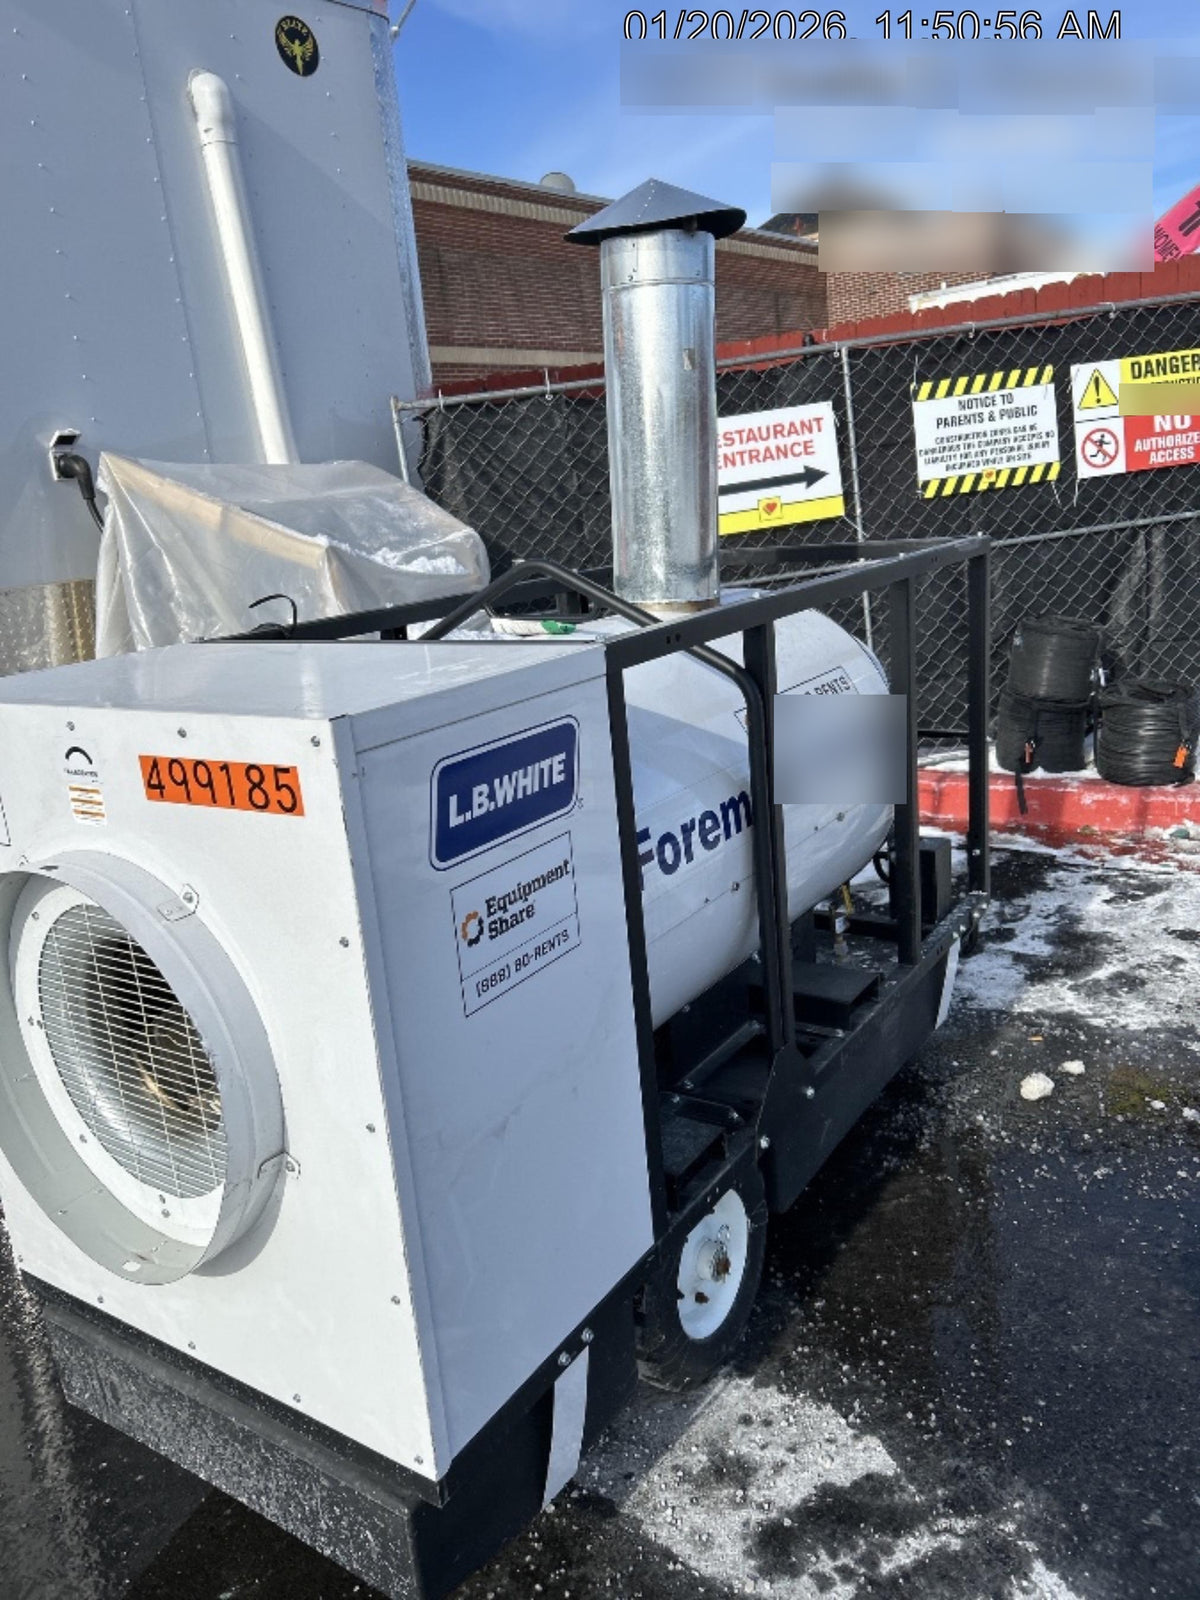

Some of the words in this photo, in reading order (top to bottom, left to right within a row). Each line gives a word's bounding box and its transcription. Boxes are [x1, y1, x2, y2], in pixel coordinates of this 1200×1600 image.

[1130, 353, 1200, 380] DANGER
[936, 412, 984, 429] PARENTS
[988, 410, 996, 423] &
[1000, 405, 1038, 420] PUBLIC
[958, 394, 997, 411] NOTICE
[1001, 392, 1014, 405] TO
[1149, 446, 1195, 464] ACCESS
[147, 758, 298, 813] 499185
[449, 752, 566, 828] L.B.WHITE
[485, 859, 570, 918] Equipment
[488, 903, 536, 940] Share
[476, 963, 511, 998] (888)
